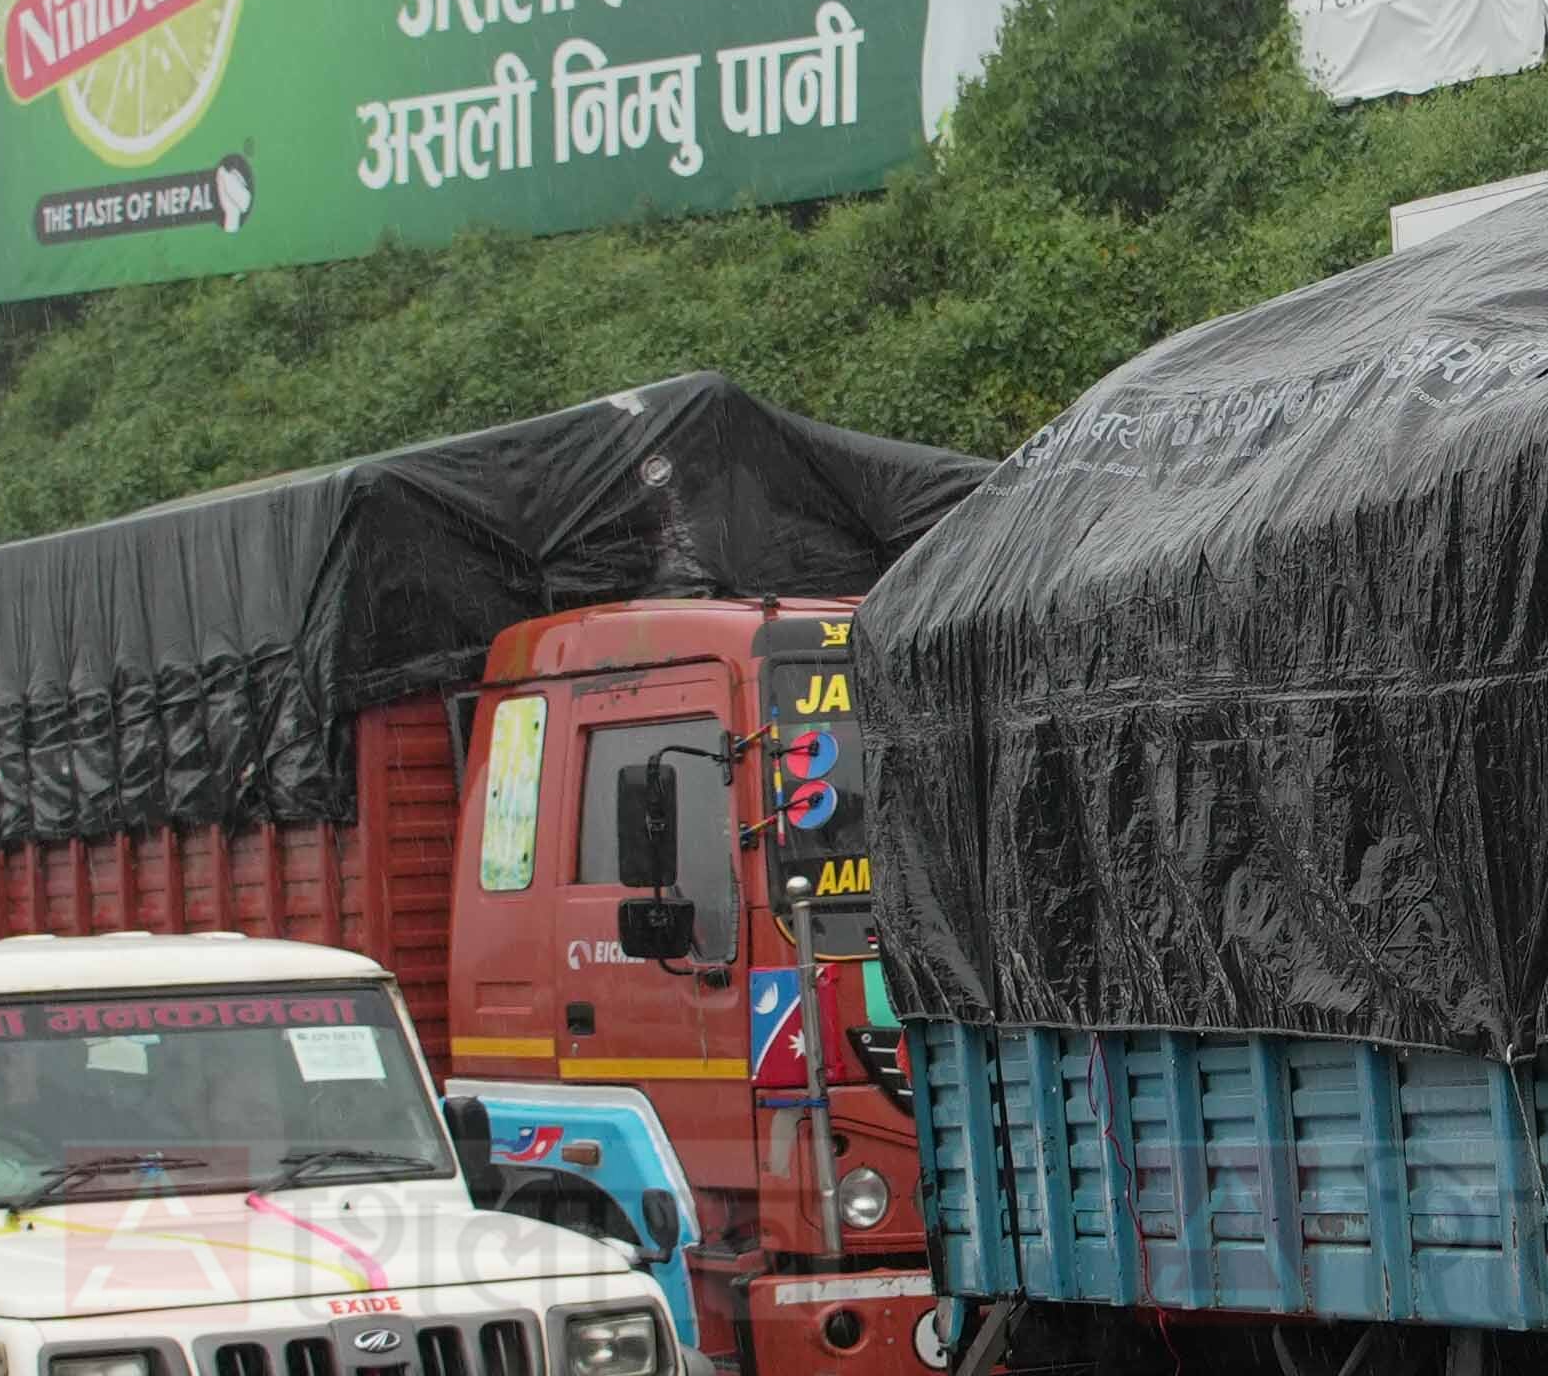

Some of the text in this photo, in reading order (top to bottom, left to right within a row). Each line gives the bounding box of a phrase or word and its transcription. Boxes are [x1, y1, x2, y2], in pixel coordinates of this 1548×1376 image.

[356, 0, 865, 190] असली निम्बु पानी
[43, 183, 213, 233] THE TASTE OF NEPAL
[327, 1295, 402, 1315] EXIDE
